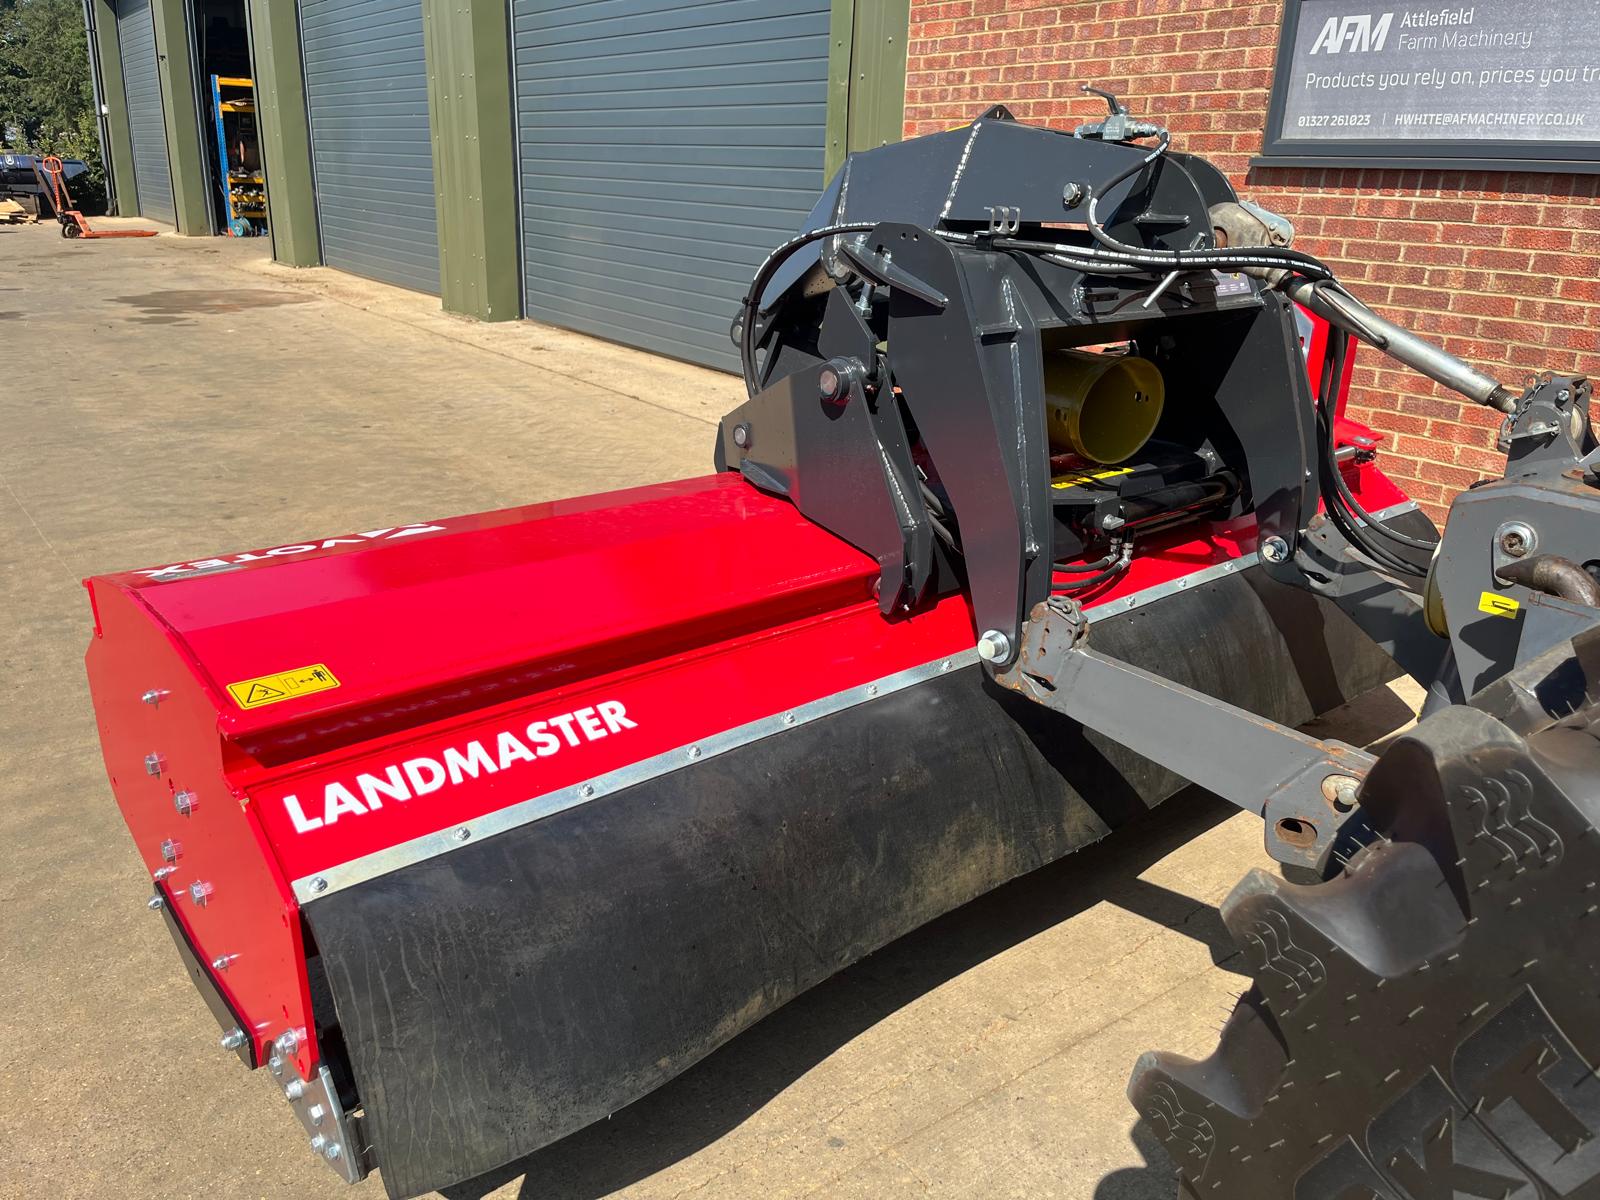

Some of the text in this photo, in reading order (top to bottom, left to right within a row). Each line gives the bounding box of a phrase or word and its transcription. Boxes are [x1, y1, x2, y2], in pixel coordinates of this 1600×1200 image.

[1400, 8, 1474, 28] Attlefield
[1309, 13, 1394, 55] AFM
[1398, 29, 1533, 50] Farm Machinery
[1305, 72, 1375, 90] Products
[1378, 71, 1410, 91] you
[1413, 68, 1446, 89] rely
[1479, 66, 1535, 88] prices
[1540, 68, 1577, 87] you
[1582, 65, 1600, 82] tr
[1298, 114, 1372, 127] 01327 261023
[1394, 113, 1586, 126] HWHITE@AFMACHINERY.CO.UK
[132, 539, 366, 578] VOTEX
[282, 700, 637, 835] LANDMASTER
